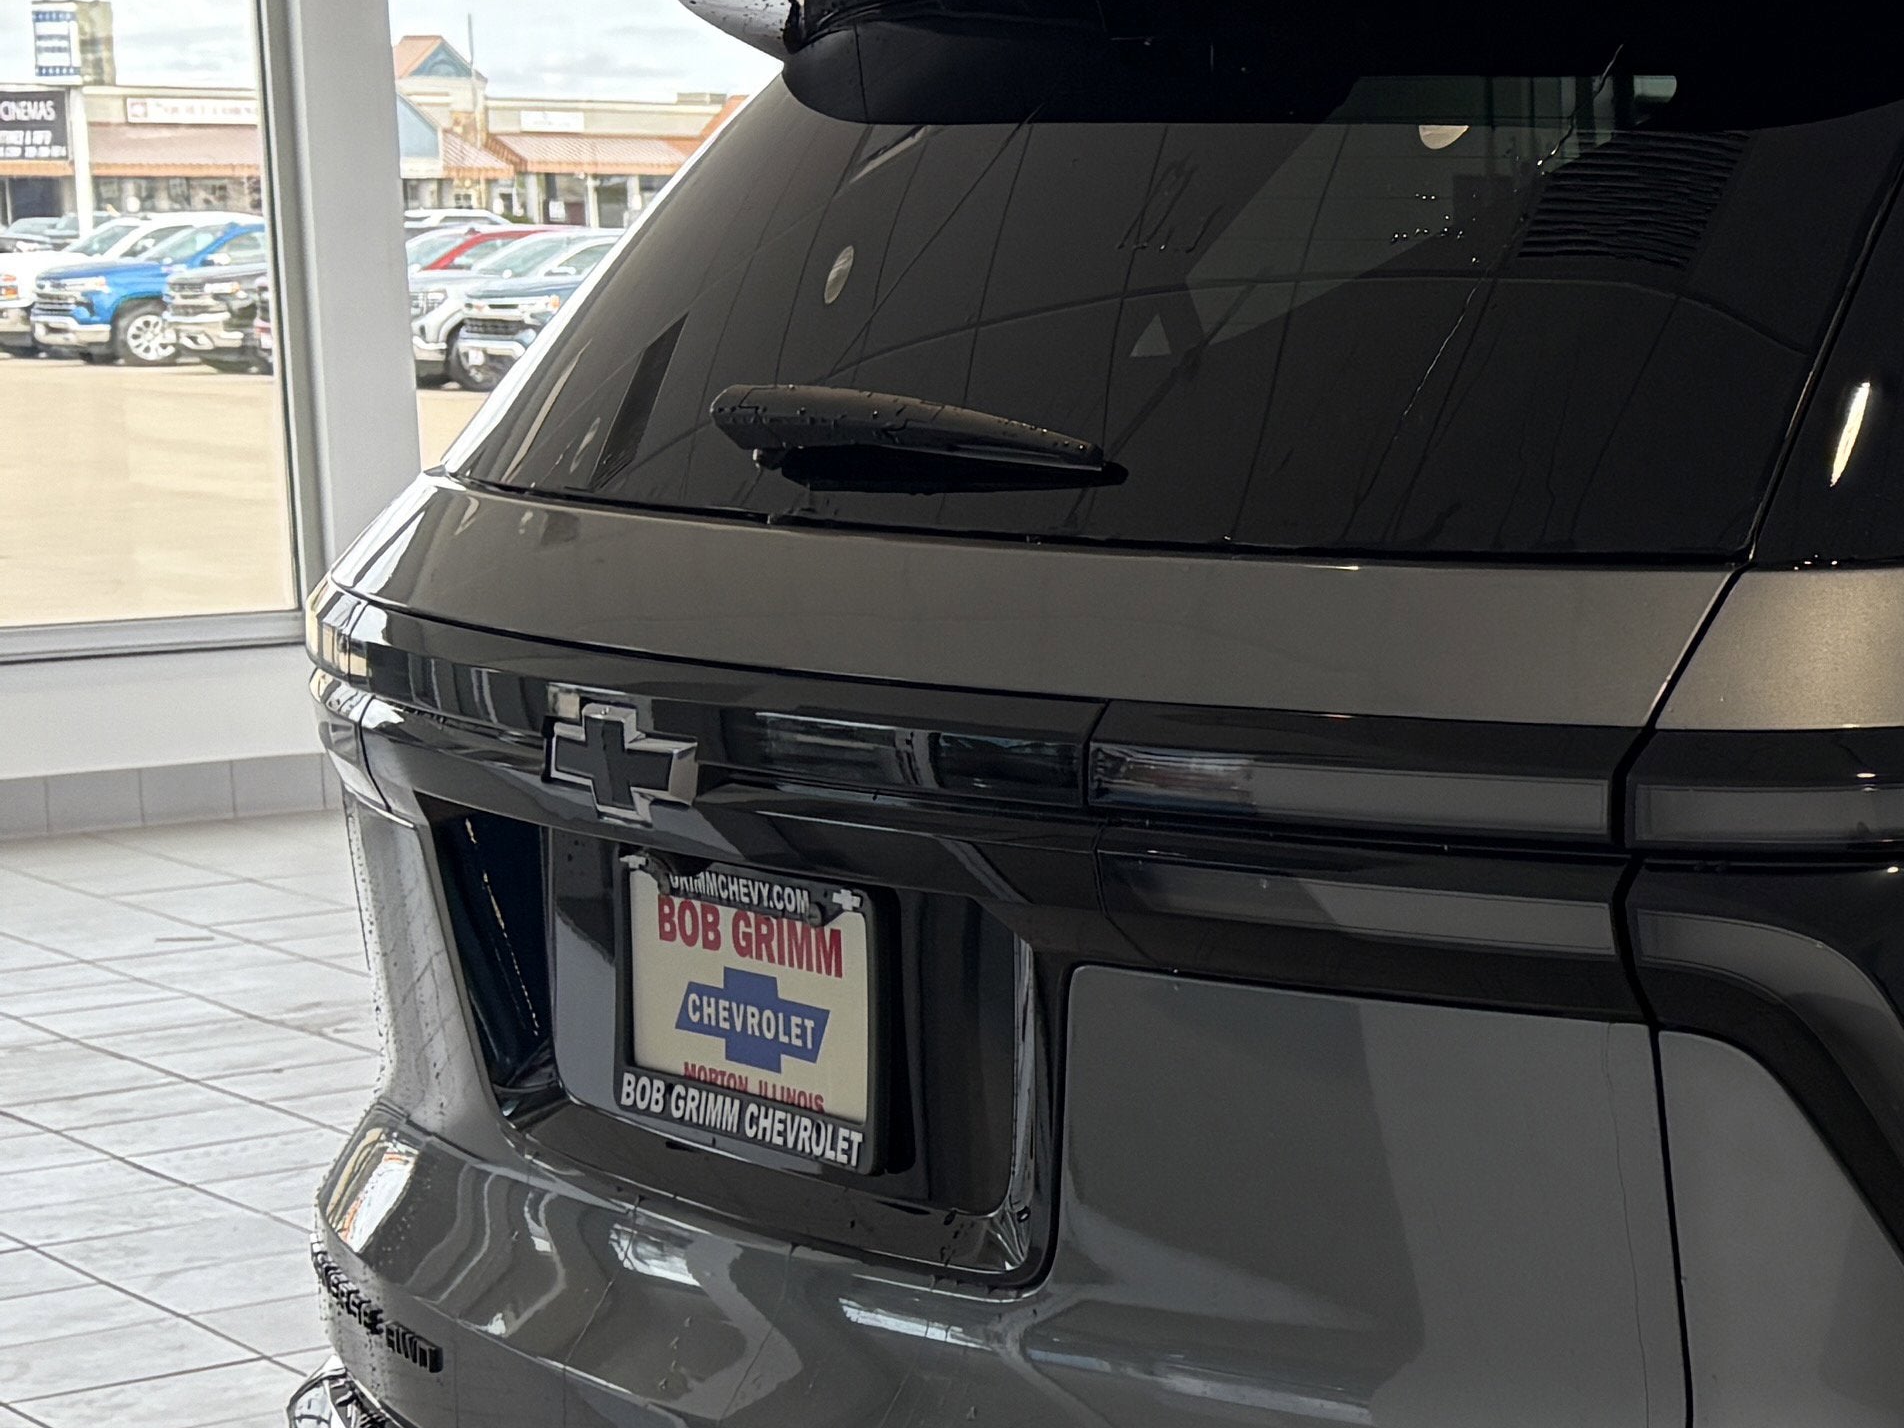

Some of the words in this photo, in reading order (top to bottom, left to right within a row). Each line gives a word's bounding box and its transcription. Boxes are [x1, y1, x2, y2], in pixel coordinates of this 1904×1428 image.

[658, 893, 721, 951] BOB
[732, 909, 842, 978] GRIMM
[688, 992, 814, 1050] CHEVROLET
[620, 1072, 666, 1113] BOB
[670, 1084, 740, 1133] GRIMM
[744, 1103, 863, 1167] CHEVROLET
